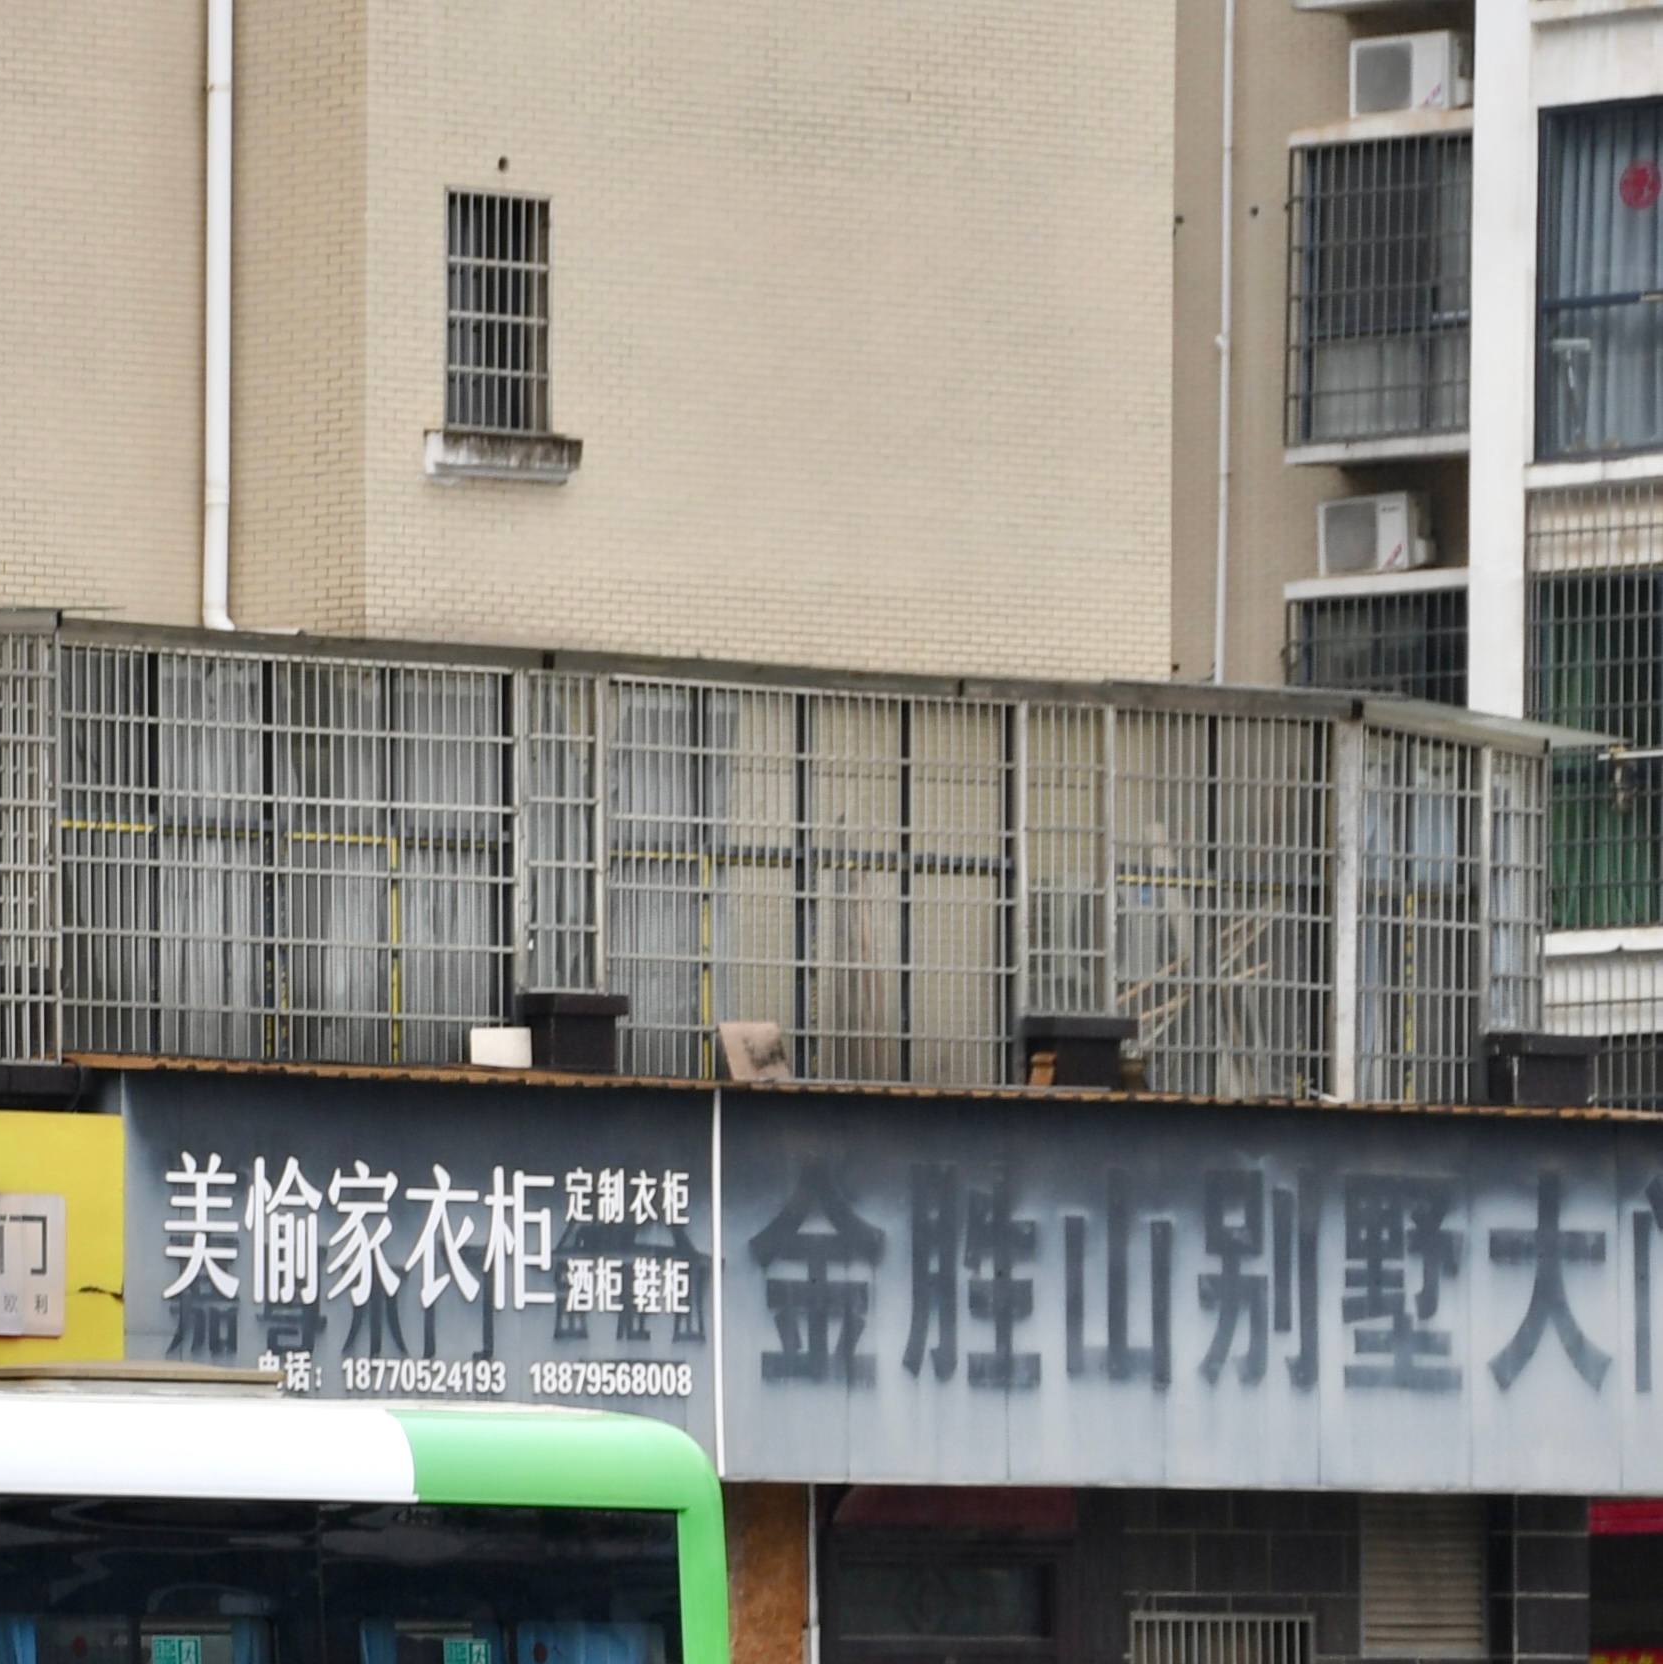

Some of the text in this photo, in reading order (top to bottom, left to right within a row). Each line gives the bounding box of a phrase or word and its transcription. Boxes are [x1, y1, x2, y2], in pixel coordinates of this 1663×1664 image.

[565, 1166, 691, 1225] 定制衣柜
[163, 1151, 556, 1311] 美愉家衣柜
[566, 1257, 624, 1313] 酒柜
[633, 1258, 691, 1313] 鞋柜
[749, 1160, 1663, 1396] 金胜山别墅大
[341, 1357, 507, 1394] 18770524193
[529, 1362, 693, 1397] 18879568008
